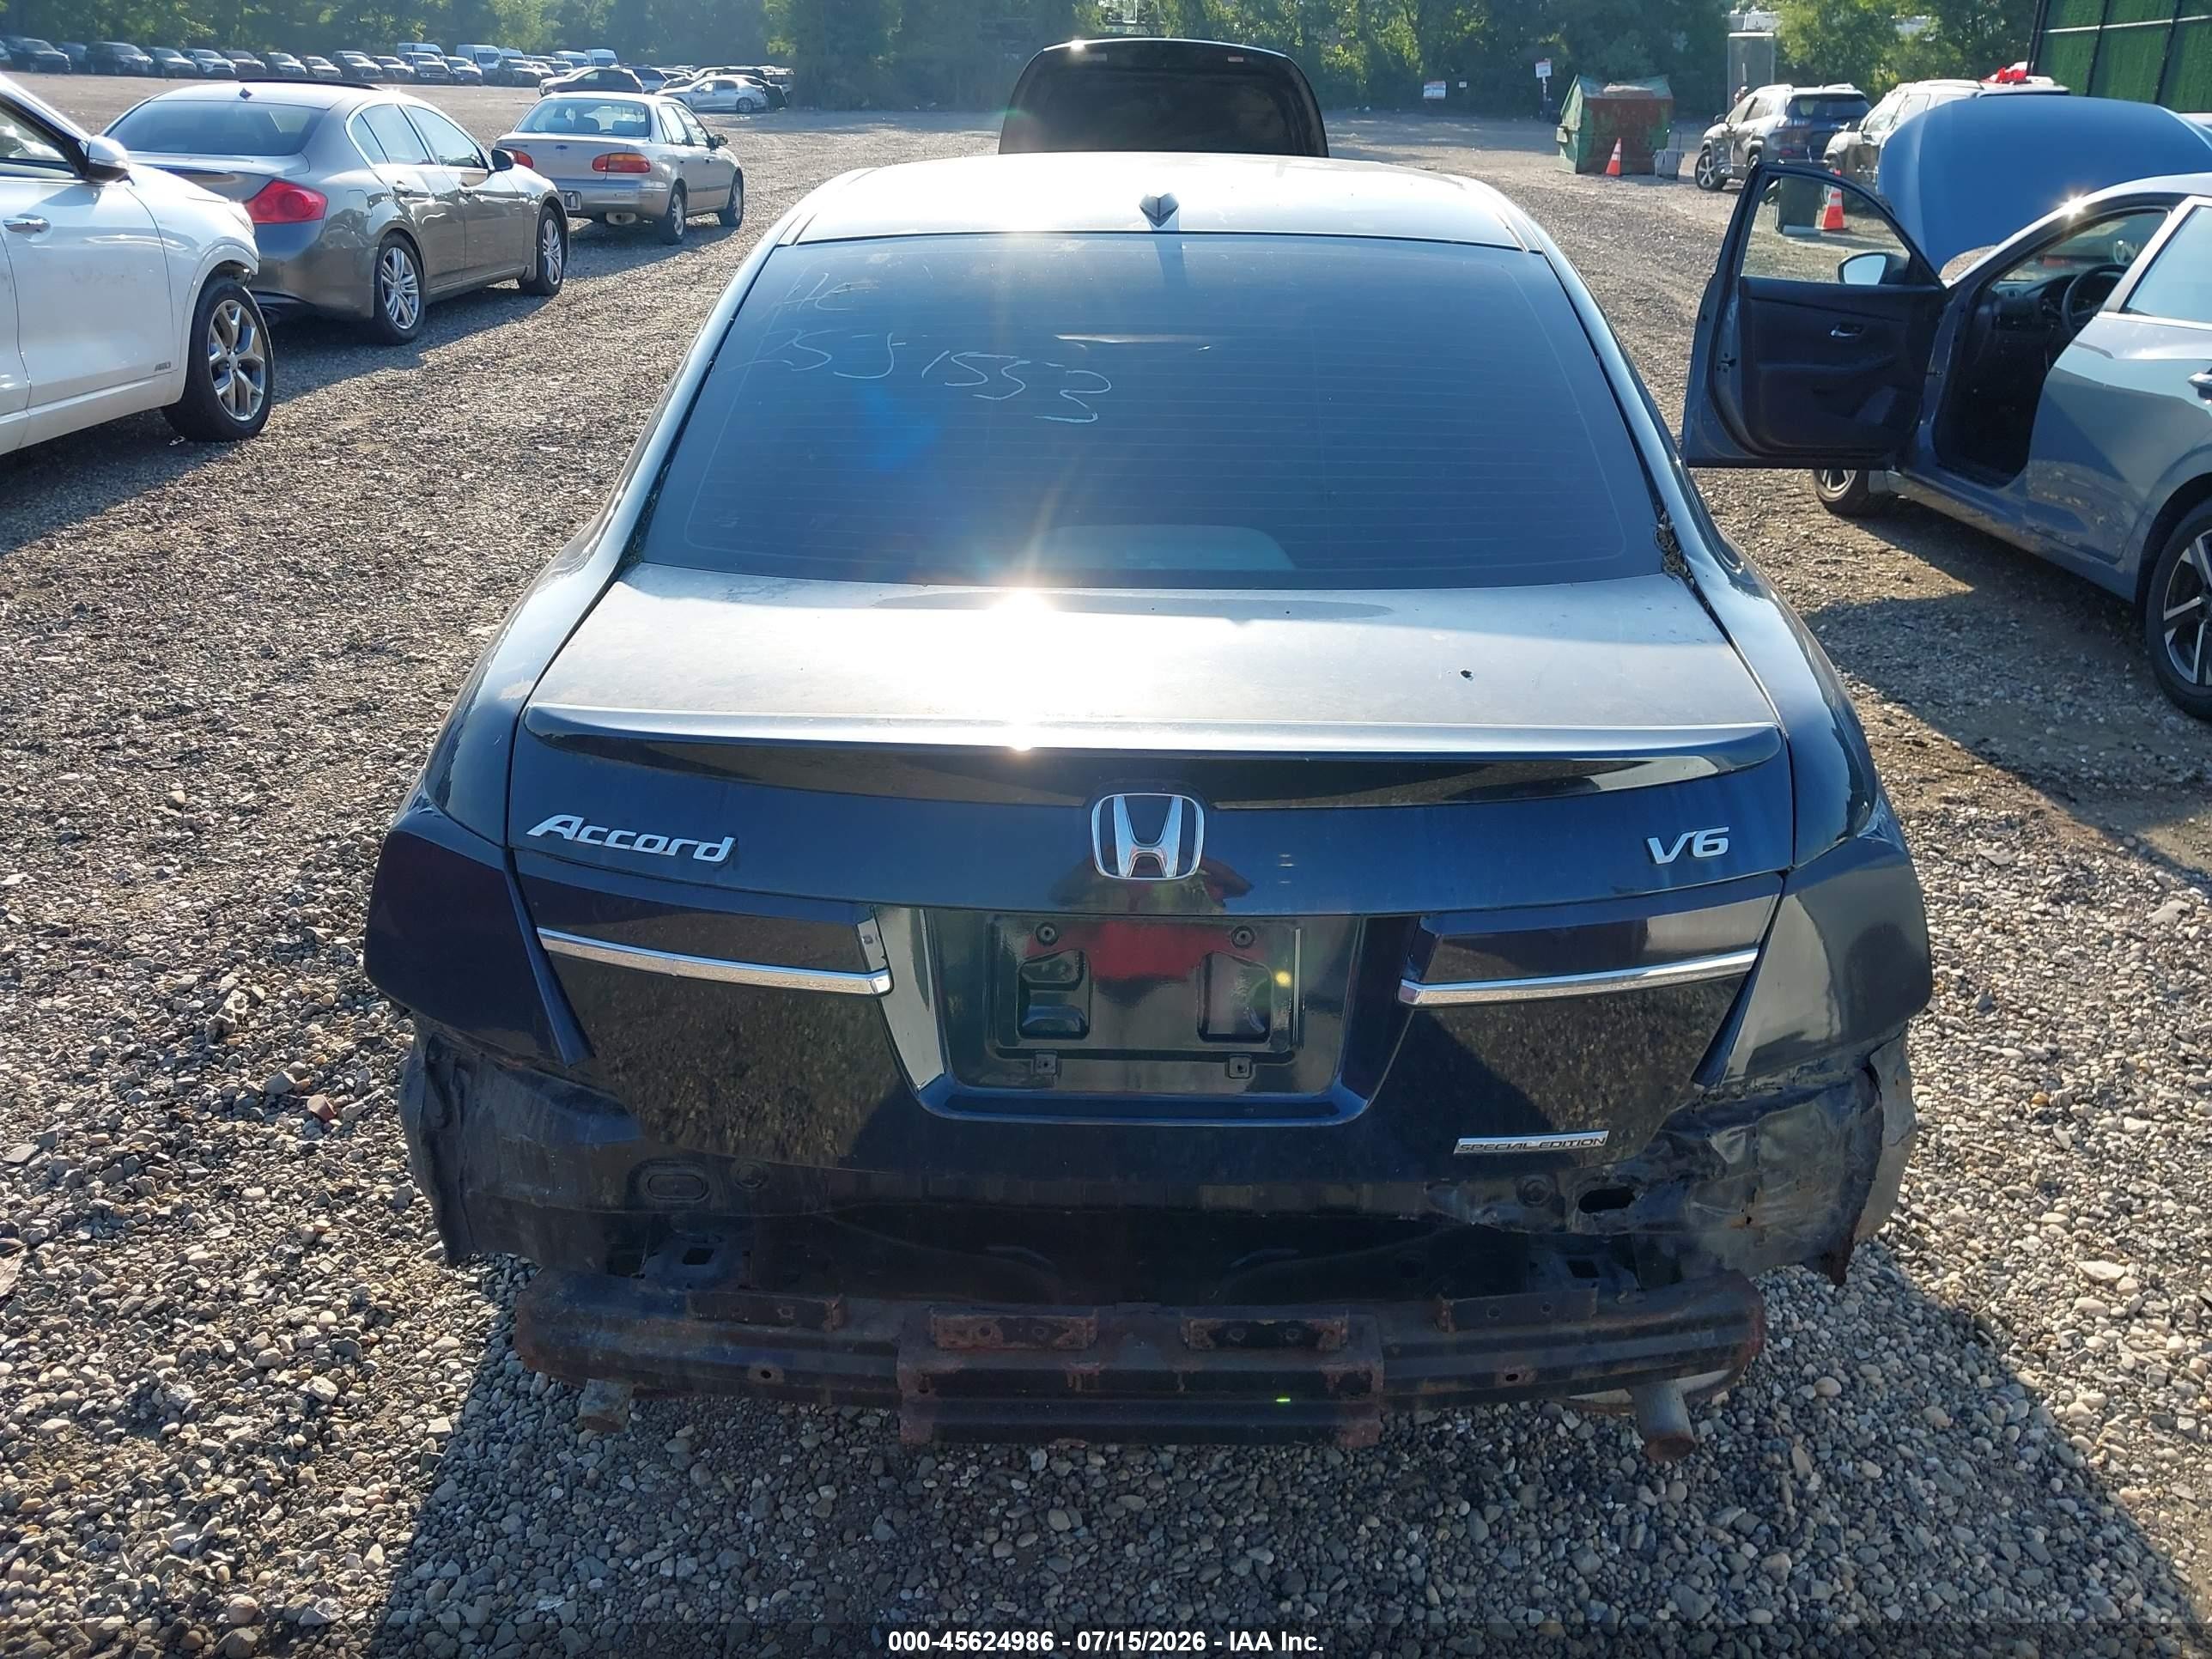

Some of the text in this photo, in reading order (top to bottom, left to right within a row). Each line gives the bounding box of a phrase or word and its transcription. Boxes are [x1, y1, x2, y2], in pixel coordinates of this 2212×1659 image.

[526, 813, 738, 863] Accord
[1647, 826, 1730, 865] V6
[1458, 1137, 1606, 1152] SPECIAL EDITION
